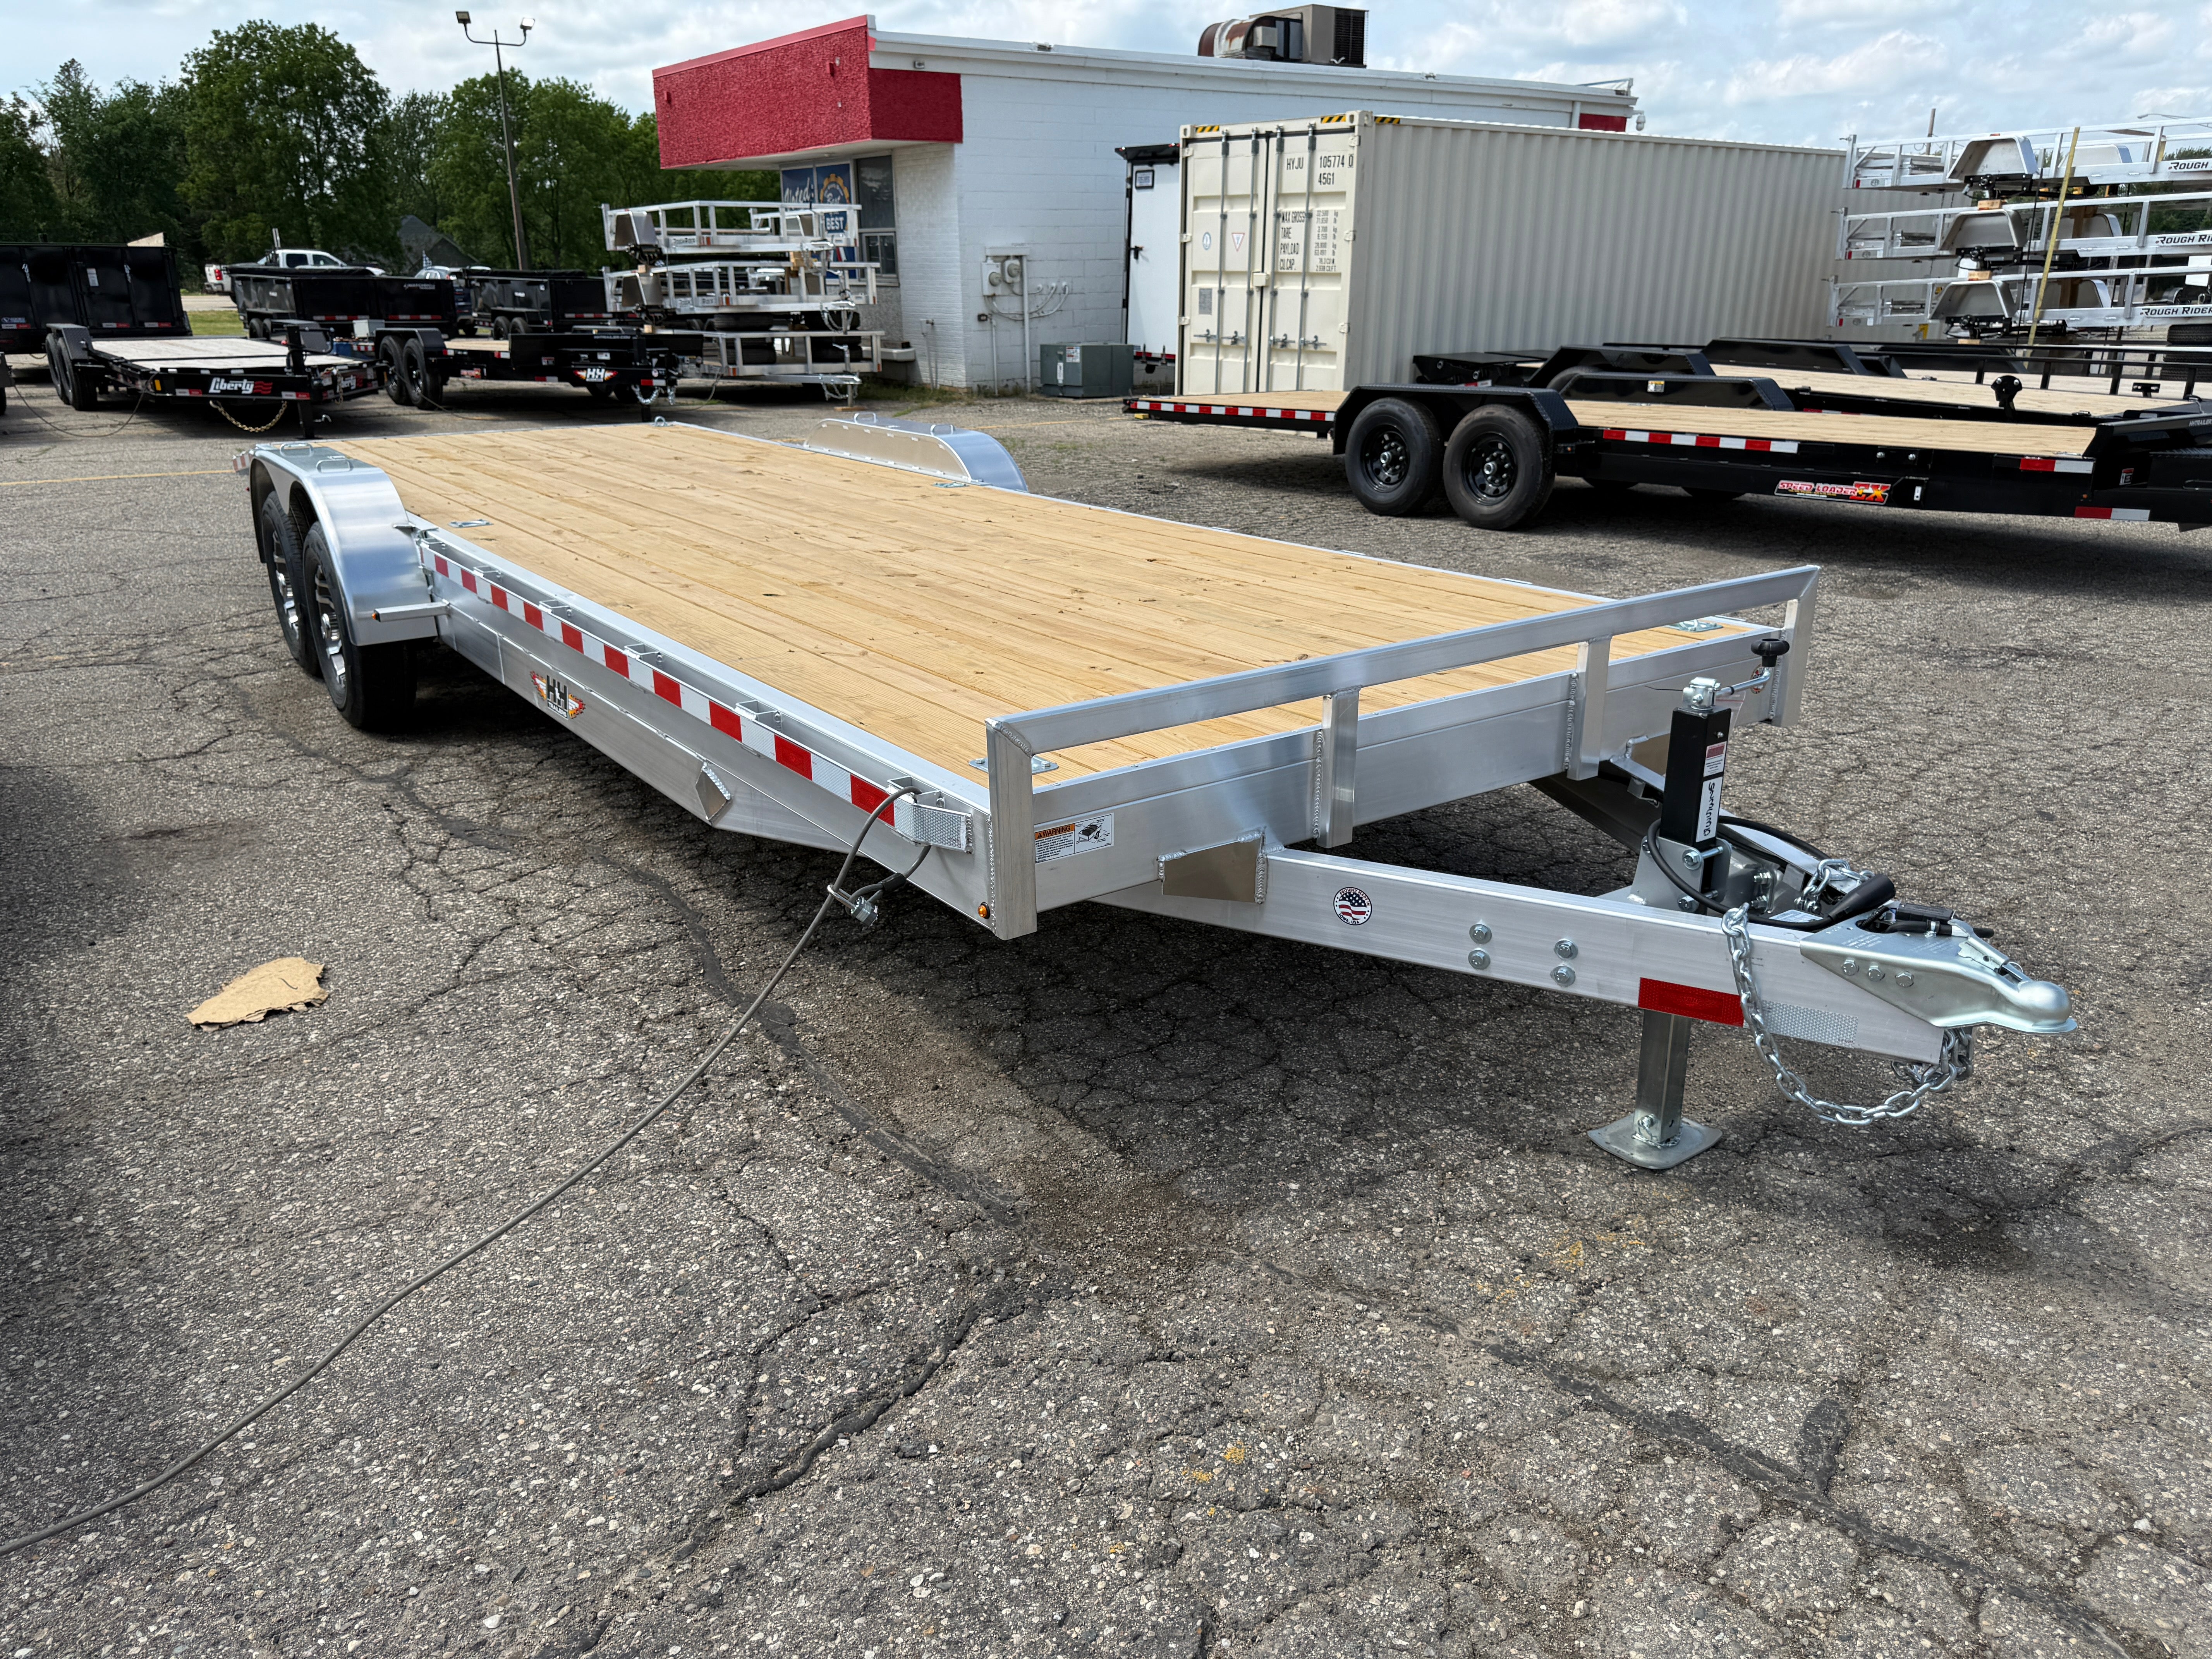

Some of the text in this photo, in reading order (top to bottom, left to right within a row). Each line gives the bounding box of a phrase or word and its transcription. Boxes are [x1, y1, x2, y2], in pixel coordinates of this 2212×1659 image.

[1286, 155, 1354, 170] HYJU 105774 0
[2170, 161, 2209, 170] ROUGH
[1318, 172, 1334, 185] 45G1
[826, 216, 844, 230] BEST
[1291, 211, 1305, 223] GROSS
[1281, 227, 1292, 239] TARE
[208, 377, 254, 394] Liberty
[1778, 481, 1814, 491] SPEED
[1815, 483, 1858, 496] LOADER
[547, 701, 568, 719] TRAILERS
[1042, 825, 1071, 838] WARNING
[1358, 890, 1368, 901] MADE
[1338, 913, 1350, 924] IOWA,
